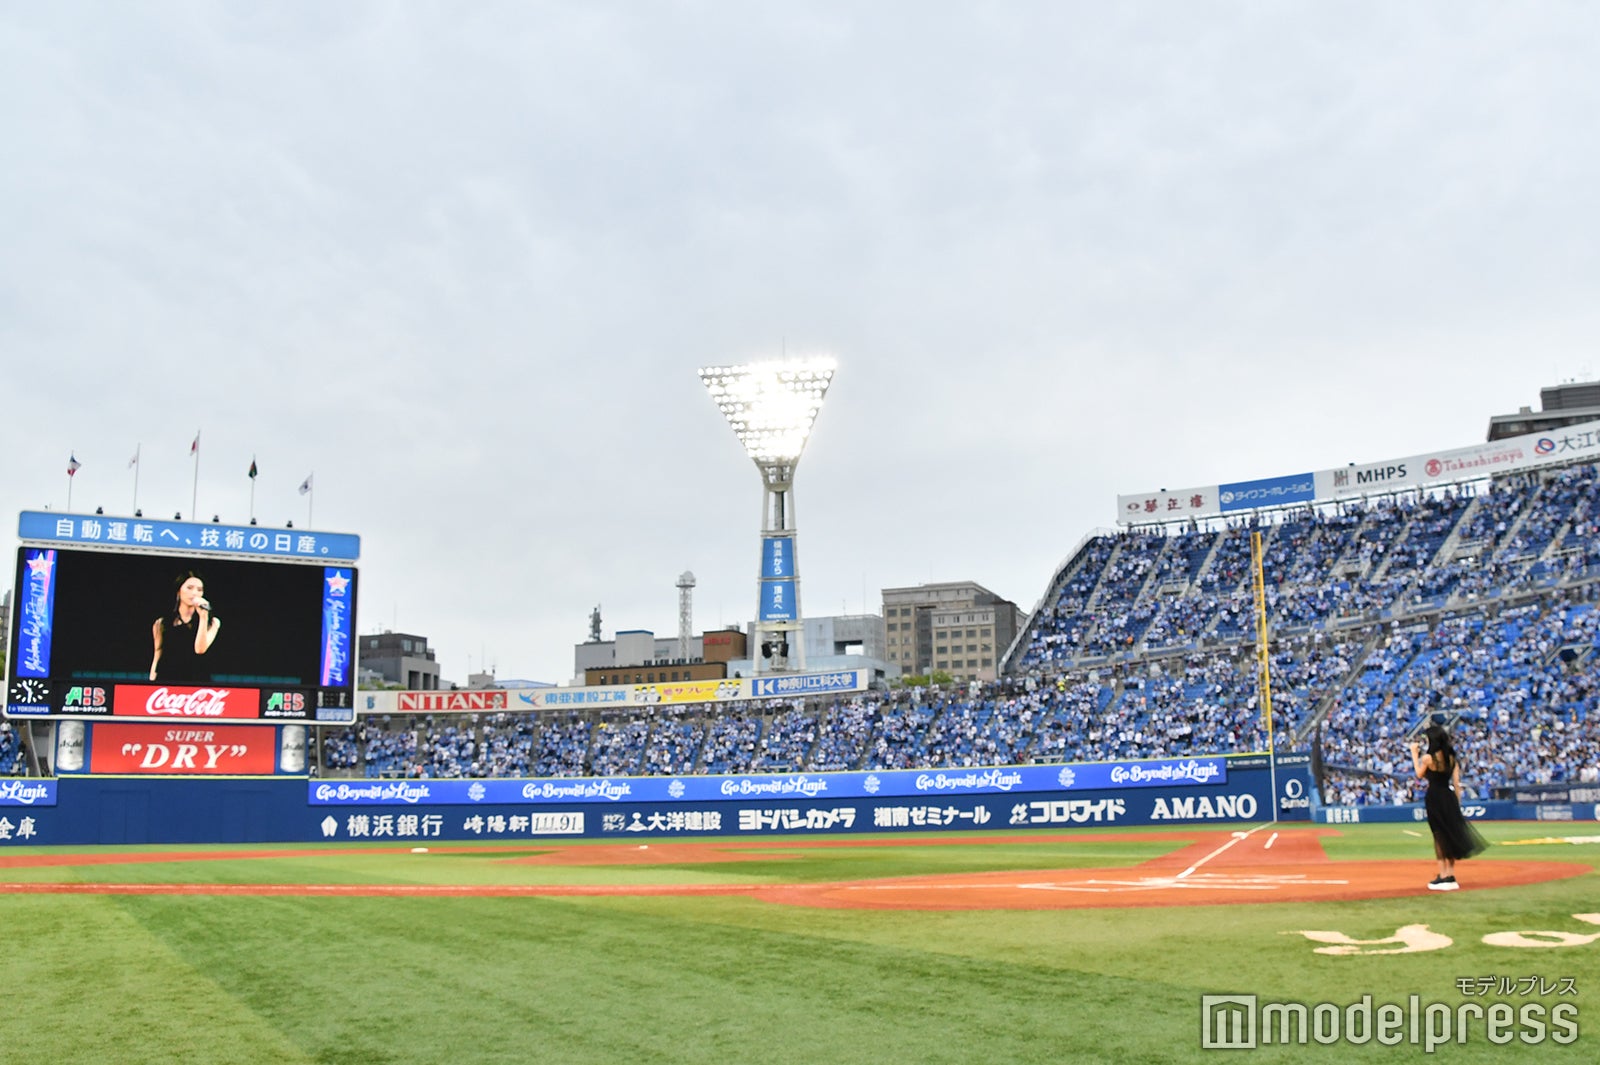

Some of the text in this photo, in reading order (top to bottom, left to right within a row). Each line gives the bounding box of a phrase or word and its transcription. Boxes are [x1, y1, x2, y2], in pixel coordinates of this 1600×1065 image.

[1442, 448, 1524, 472] Takashimaya
[1357, 463, 1407, 484] MHPS
[55, 518, 330, 555] 自動運転へ、技術の日産。
[777, 672, 852, 689] 神奈川工科大学
[146, 688, 230, 715] Coca-Cola
[399, 693, 486, 711] NITTAN
[544, 689, 627, 705] 東亜建設工業
[164, 730, 215, 742] SUPER
[915, 774, 934, 791] Go
[935, 774, 976, 789] Beyond
[1110, 766, 1130, 784] Go
[1130, 765, 1172, 782] Beyond
[315, 784, 337, 801] Go
[337, 784, 382, 800] Beyond
[522, 783, 542, 800] Go
[542, 783, 585, 799] Beyond
[720, 779, 739, 796] Go
[740, 779, 782, 795] Beyond
[873, 805, 991, 827] 湘南ゼミナール
[1029, 798, 1127, 823] コロワイド
[1150, 793, 1258, 820] AMANO
[347, 814, 444, 838] 横浜銀行
[463, 814, 530, 835] 崎陽軒
[646, 811, 722, 832] 大洋建設
[738, 807, 857, 831] ヨドバシカメラ
